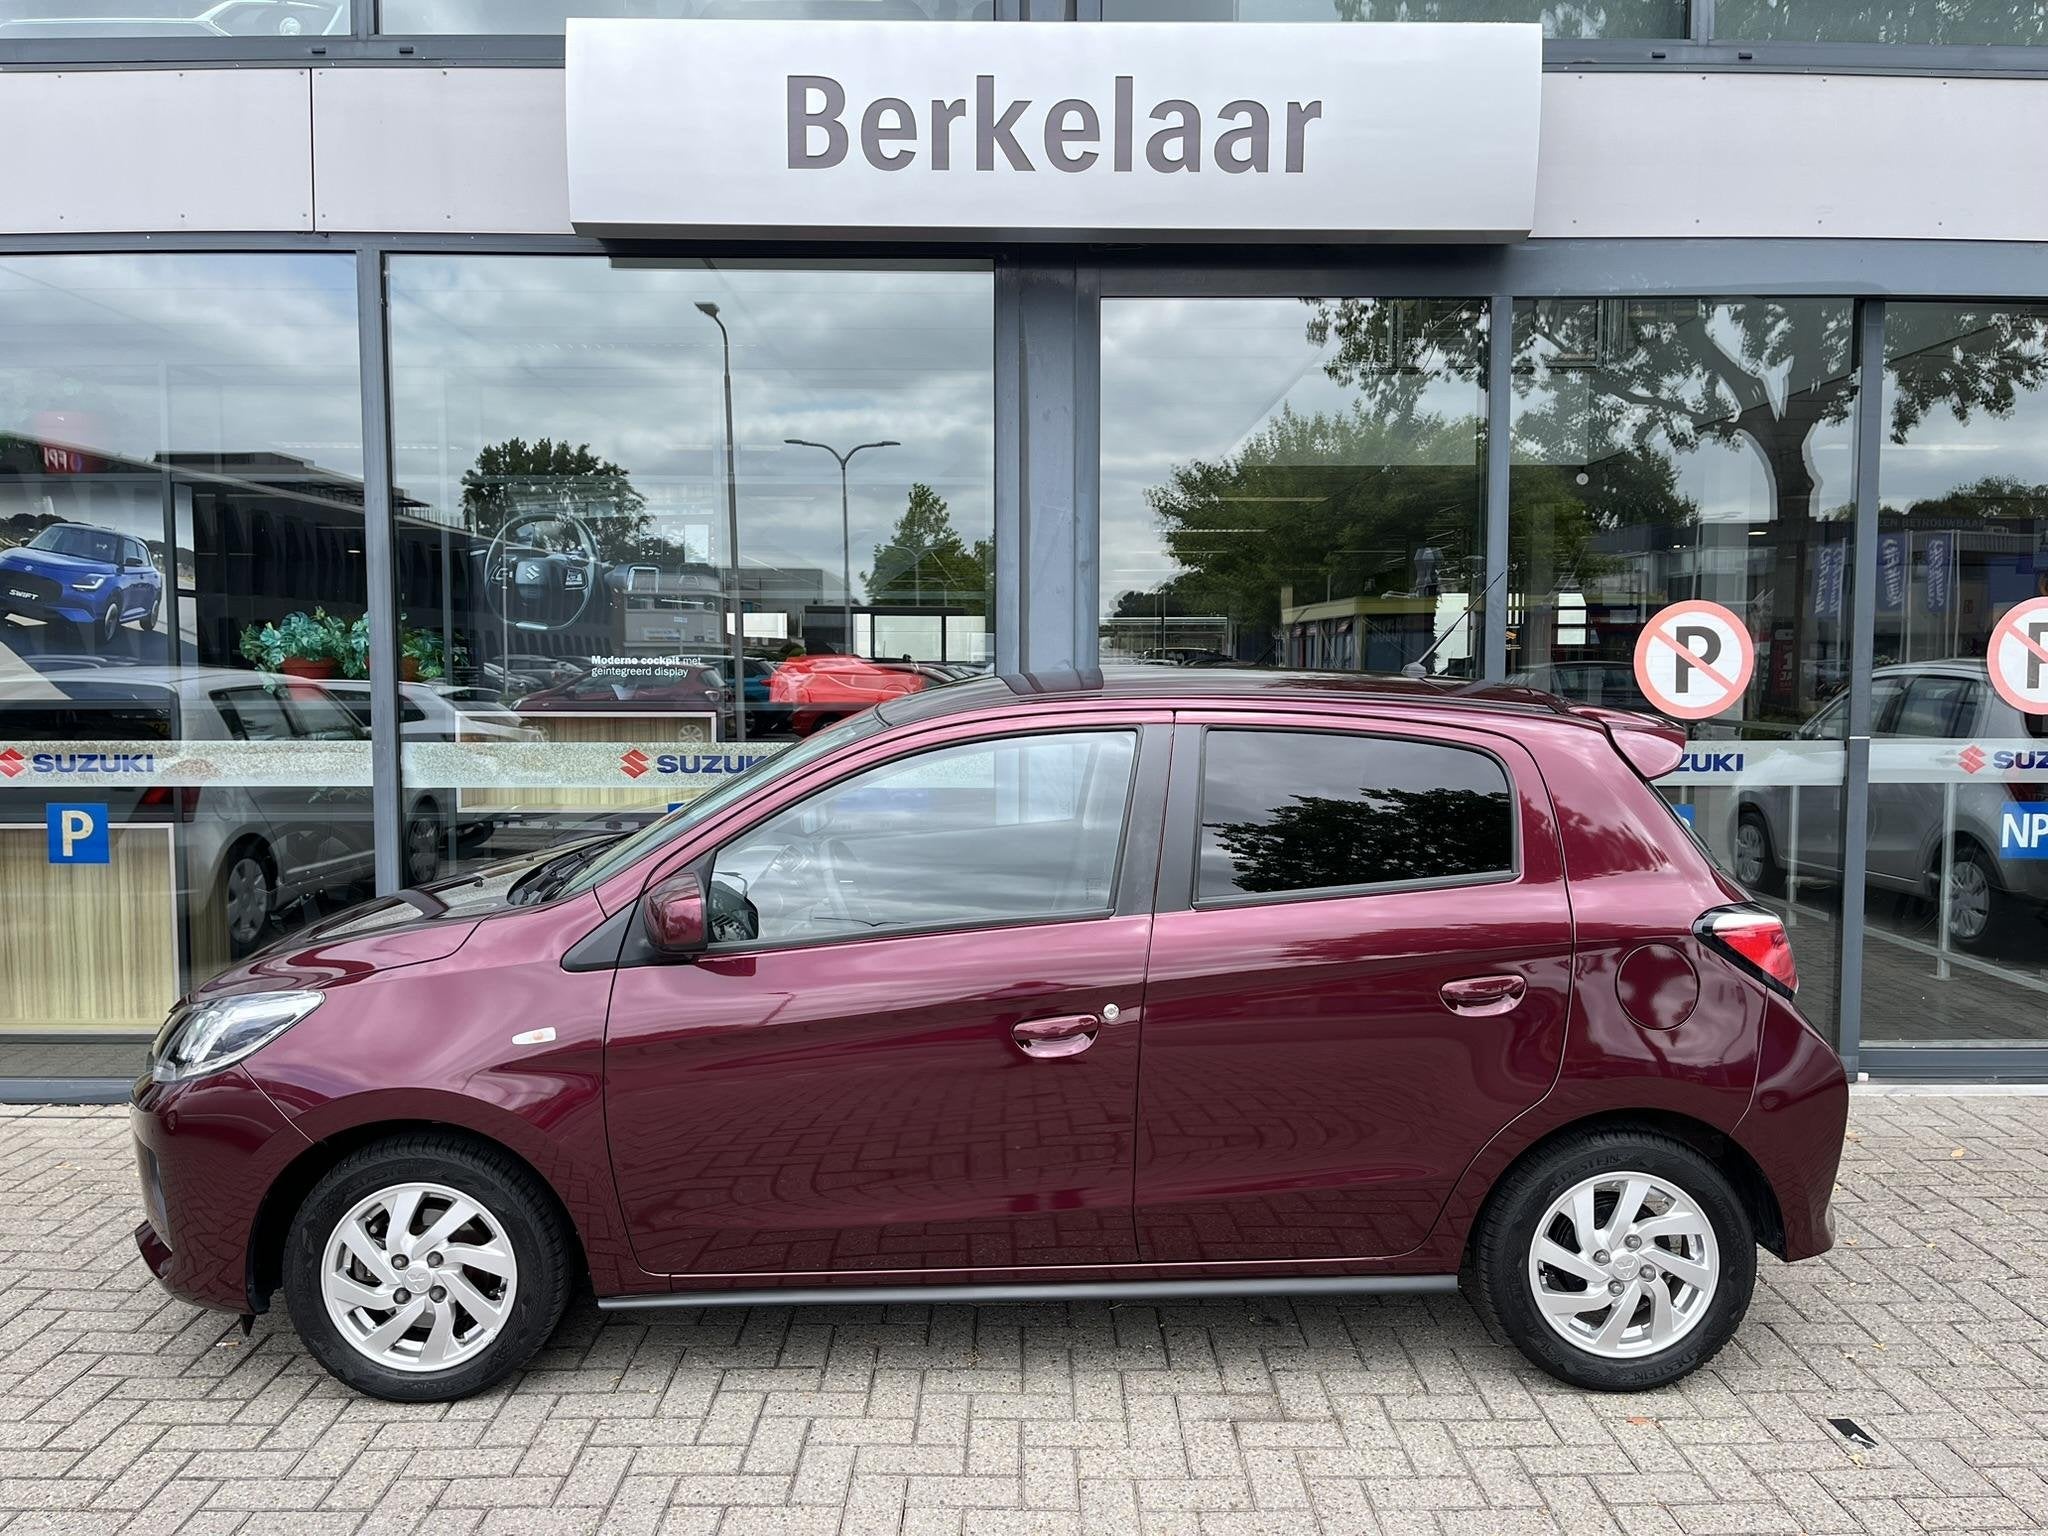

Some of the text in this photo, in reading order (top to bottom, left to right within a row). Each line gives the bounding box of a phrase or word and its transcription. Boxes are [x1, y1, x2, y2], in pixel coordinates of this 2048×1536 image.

[787, 75, 1322, 173] Berkelaar
[8, 588, 39, 600] SWIFT
[591, 655, 702, 667] Moderne cockpit met
[1675, 625, 1721, 693] P
[654, 667, 689, 678] display
[32, 753, 154, 773] SUZUKI
[656, 754, 768, 774] SUZUK
[1674, 753, 1744, 773] ZUKI
[1993, 750, 2048, 769] SUZ
[61, 810, 95, 857] P
[2002, 813, 2048, 848] NP
